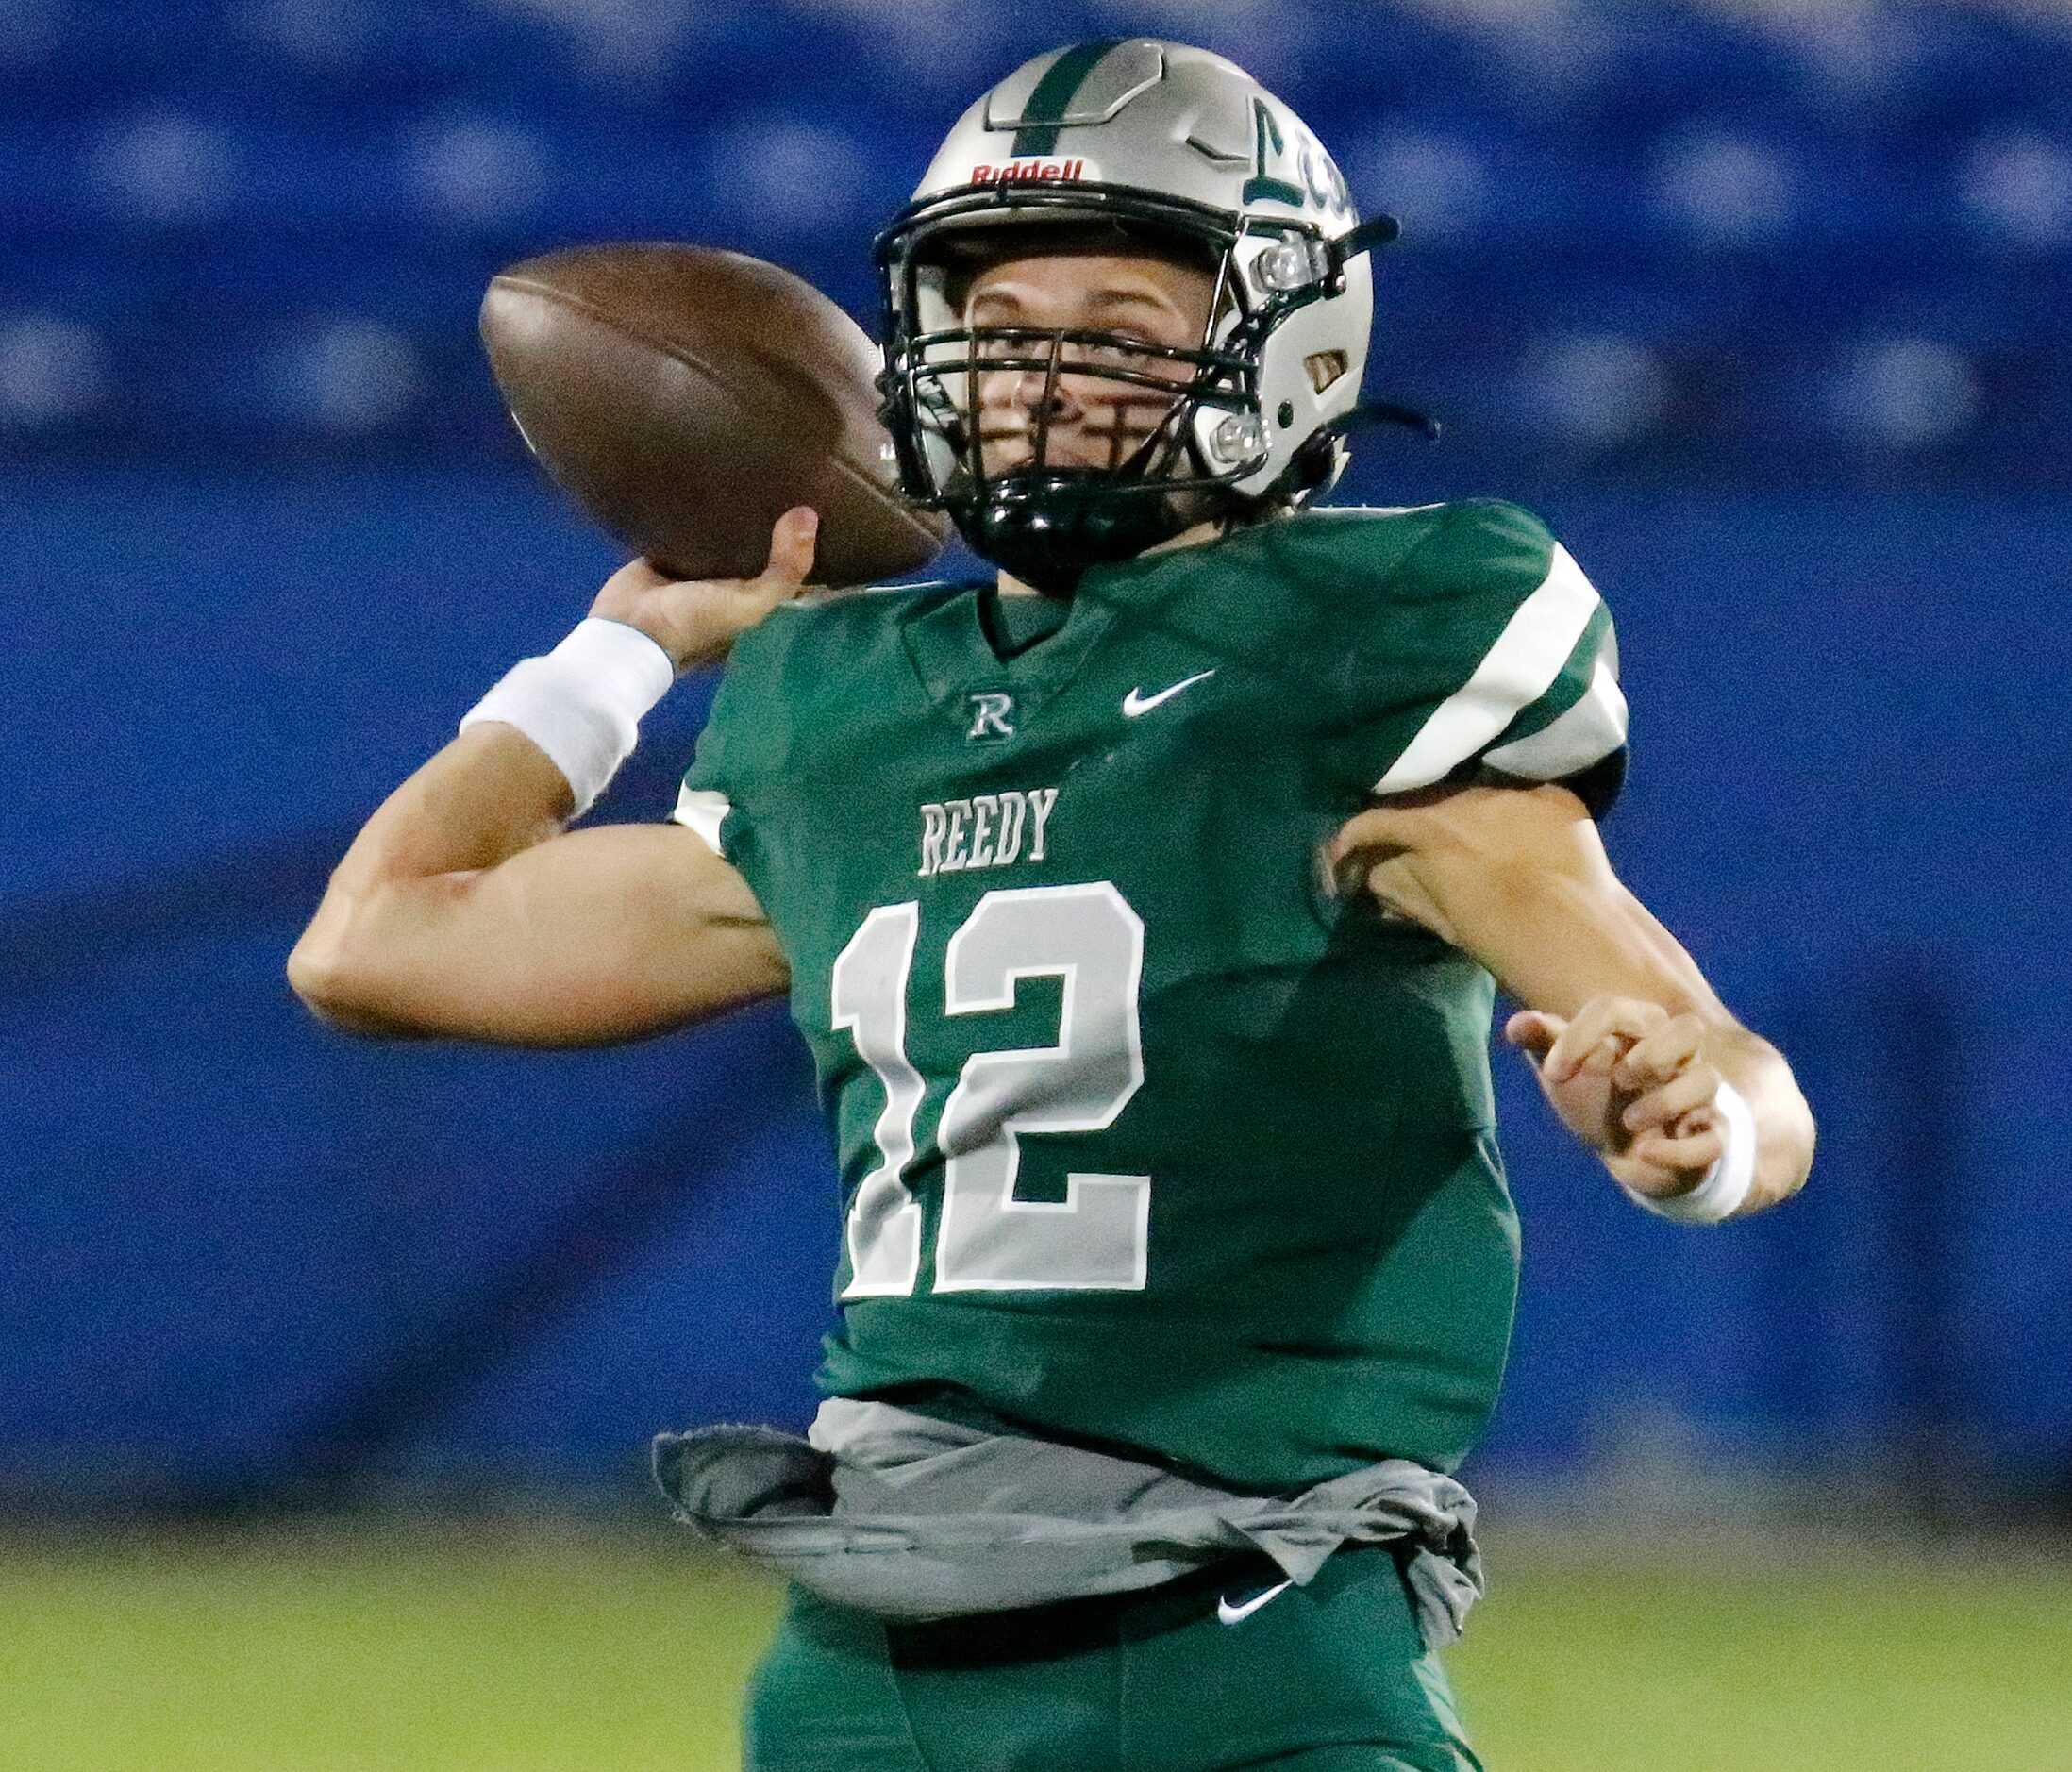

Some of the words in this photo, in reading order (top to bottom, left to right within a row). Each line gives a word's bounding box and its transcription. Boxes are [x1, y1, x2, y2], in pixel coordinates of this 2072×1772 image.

[972, 159, 1084, 184] Riddell
[968, 692, 1014, 736] R
[917, 787, 1060, 877] REEDY
[830, 879, 1151, 1297] 12
